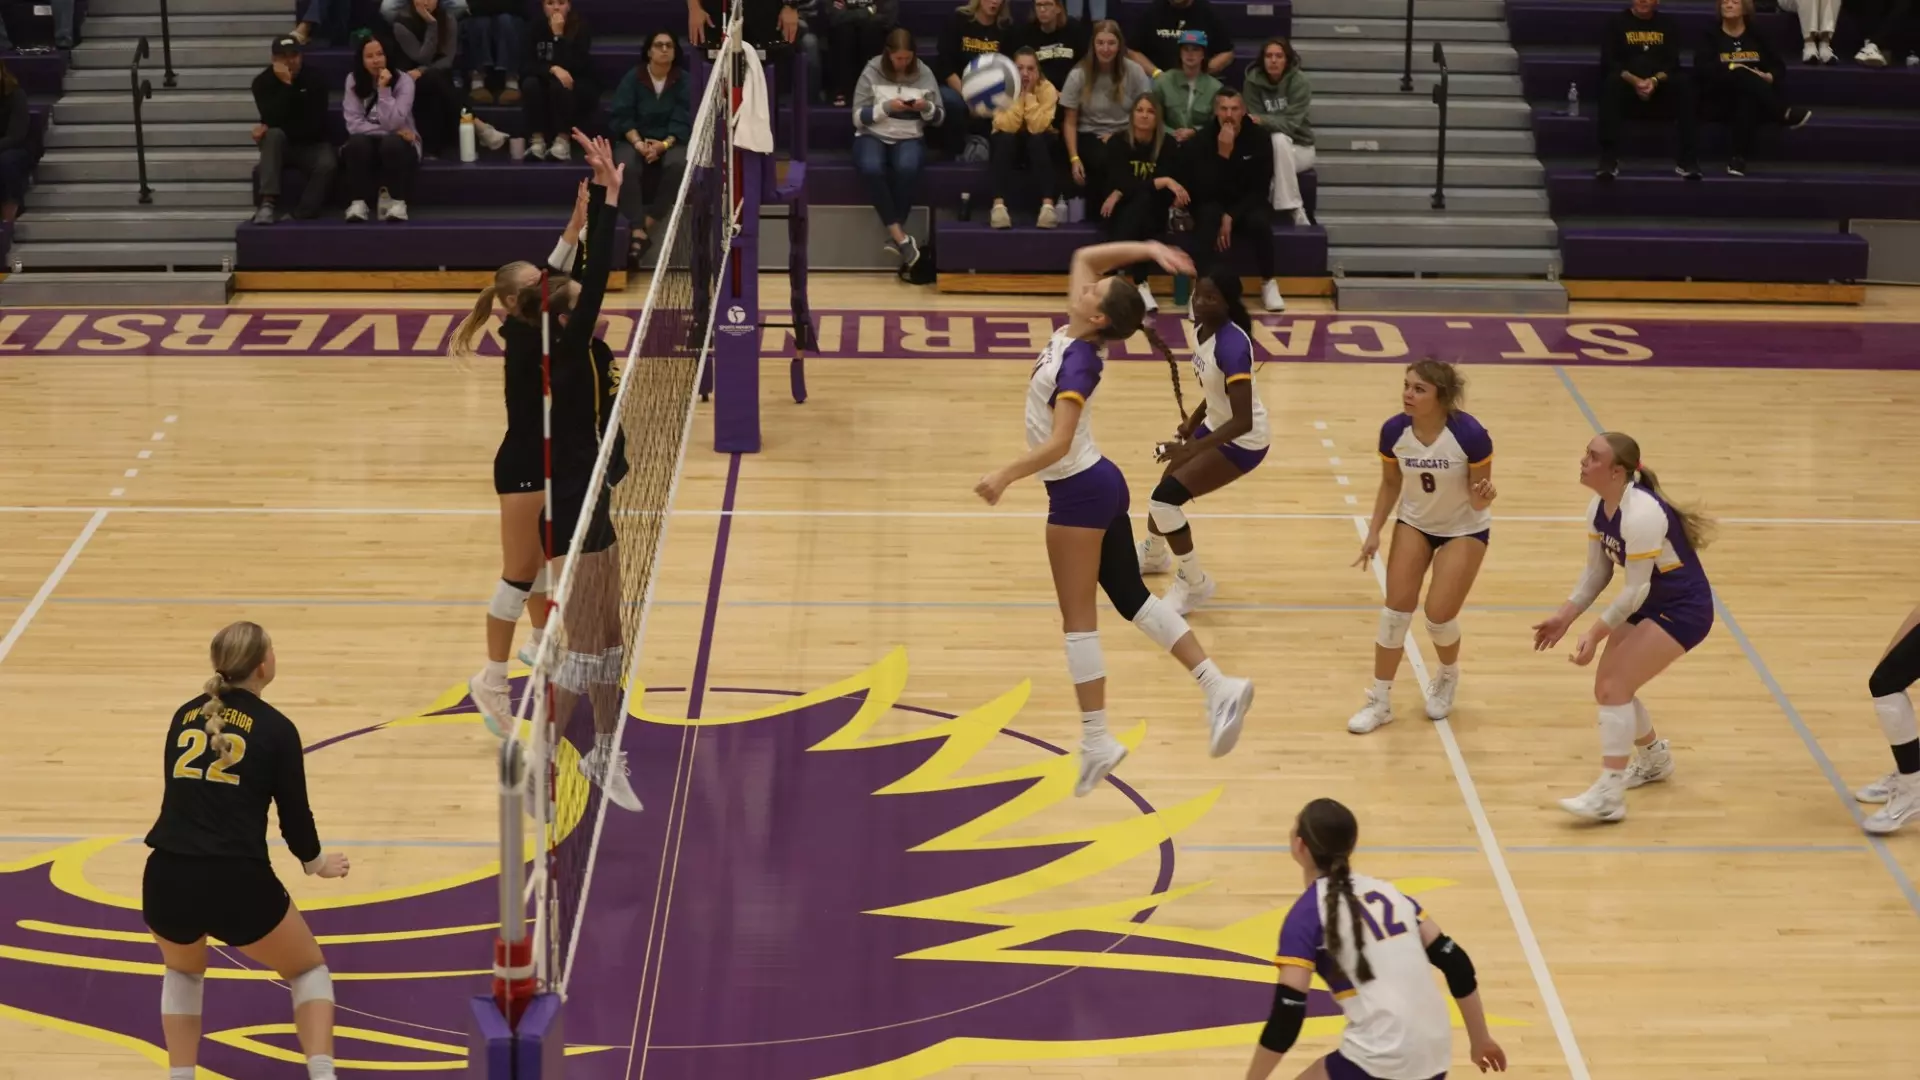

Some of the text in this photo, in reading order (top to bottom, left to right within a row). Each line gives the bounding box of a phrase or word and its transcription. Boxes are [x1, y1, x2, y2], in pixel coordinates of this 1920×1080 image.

[1446, 320, 1653, 361] ST.
[1404, 457, 1450, 470] WILDCATS
[1420, 472, 1436, 493] 8
[172, 728, 247, 786] 22
[1357, 890, 1408, 942] 12
